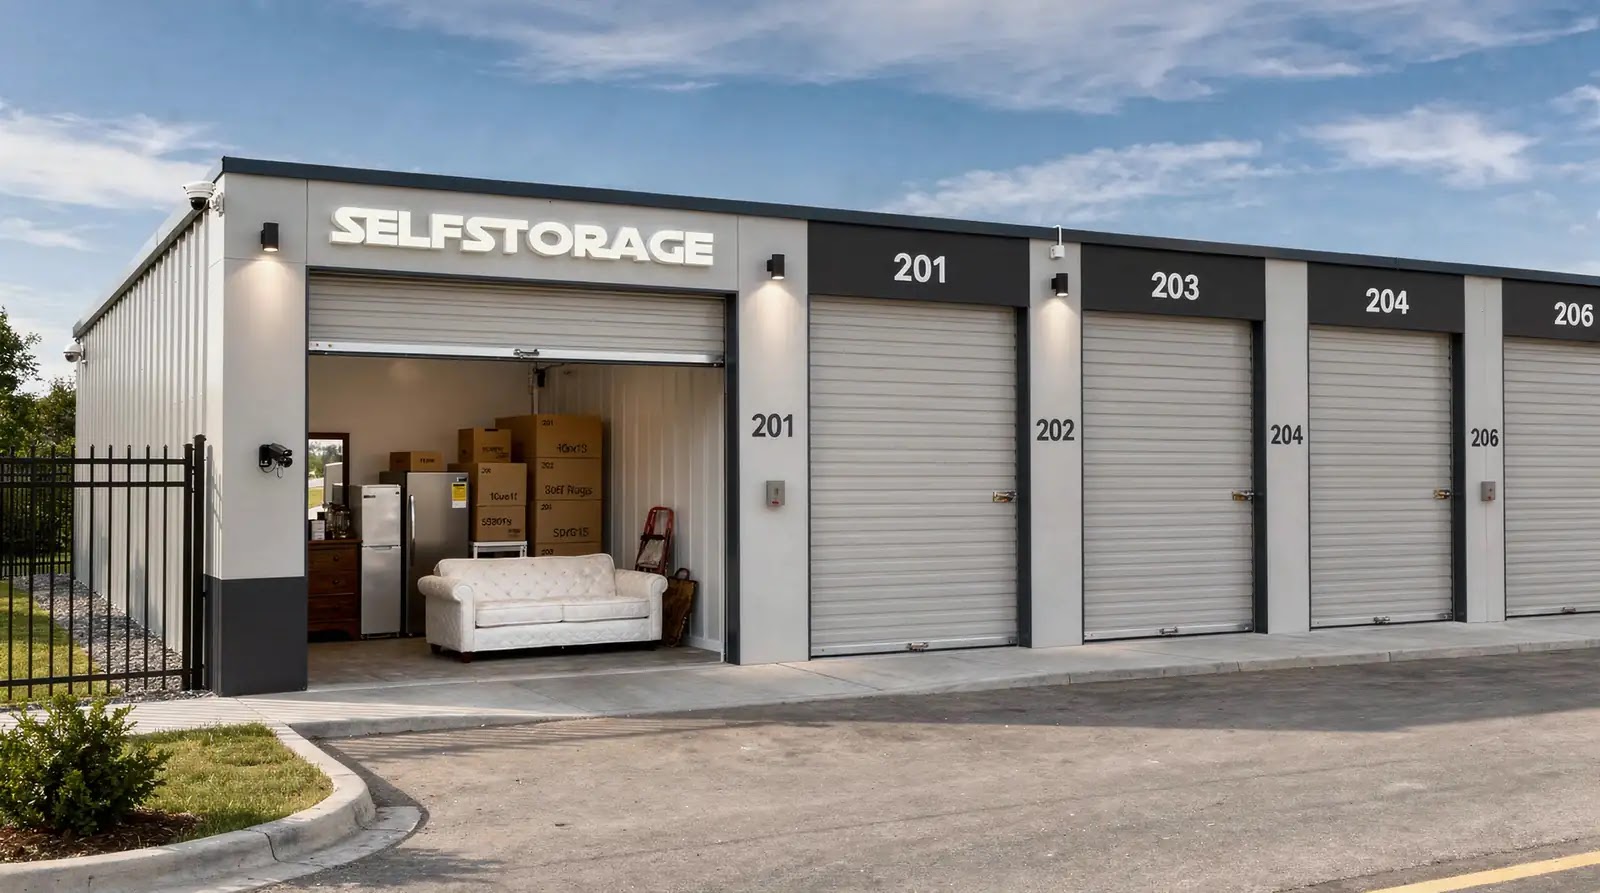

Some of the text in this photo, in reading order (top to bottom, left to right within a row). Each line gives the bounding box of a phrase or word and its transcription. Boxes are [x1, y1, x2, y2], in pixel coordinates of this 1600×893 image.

[329, 206, 714, 267] SELFSTORAGE
[893, 252, 946, 284] 201
[1151, 271, 1200, 301] 203
[1365, 287, 1410, 315] 204
[1554, 301, 1594, 327] 206
[751, 413, 793, 438] 201
[1036, 418, 1075, 442] 202
[1270, 424, 1304, 445] 204
[1470, 428, 1499, 447] 206
